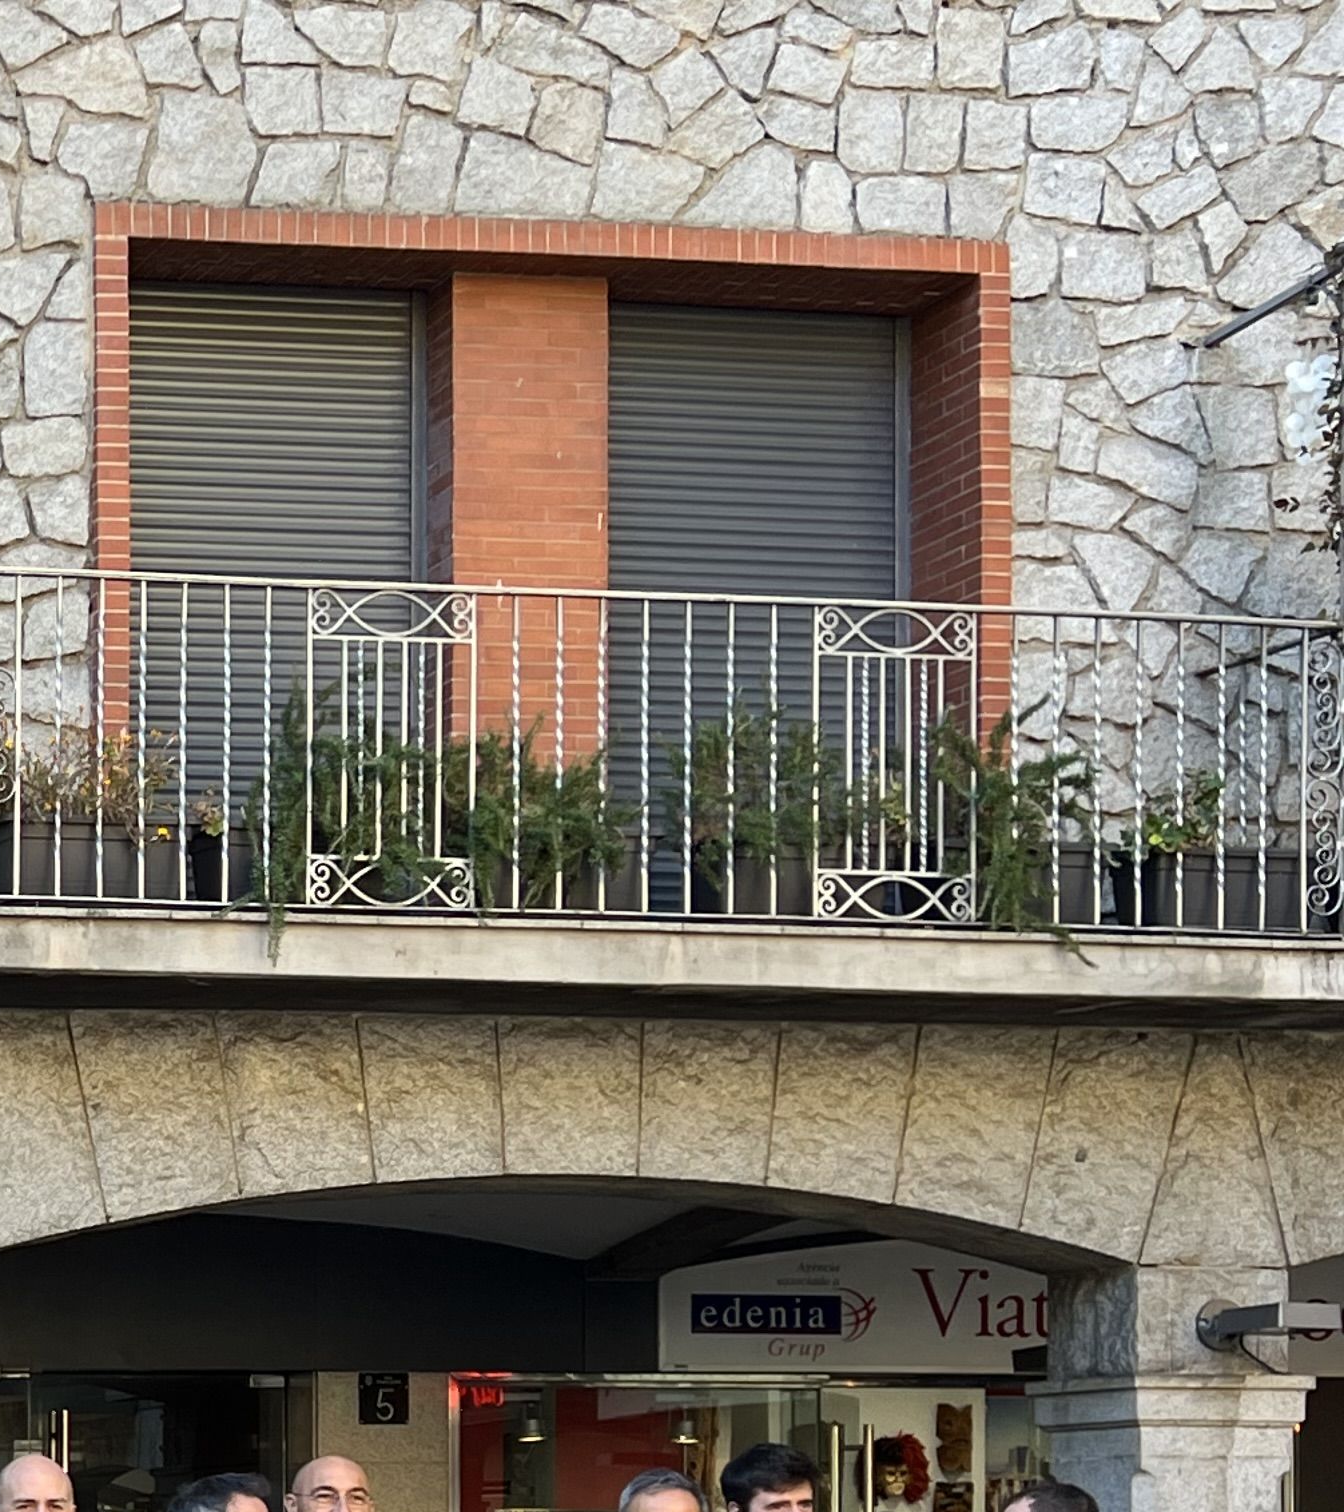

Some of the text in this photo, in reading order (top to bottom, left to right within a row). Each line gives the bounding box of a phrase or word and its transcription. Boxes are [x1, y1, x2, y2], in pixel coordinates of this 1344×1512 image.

[700, 1298, 826, 1329] edenia
[913, 1268, 1048, 1339] Viat
[767, 1338, 826, 1361] Grup
[376, 1388, 395, 1421] 5
